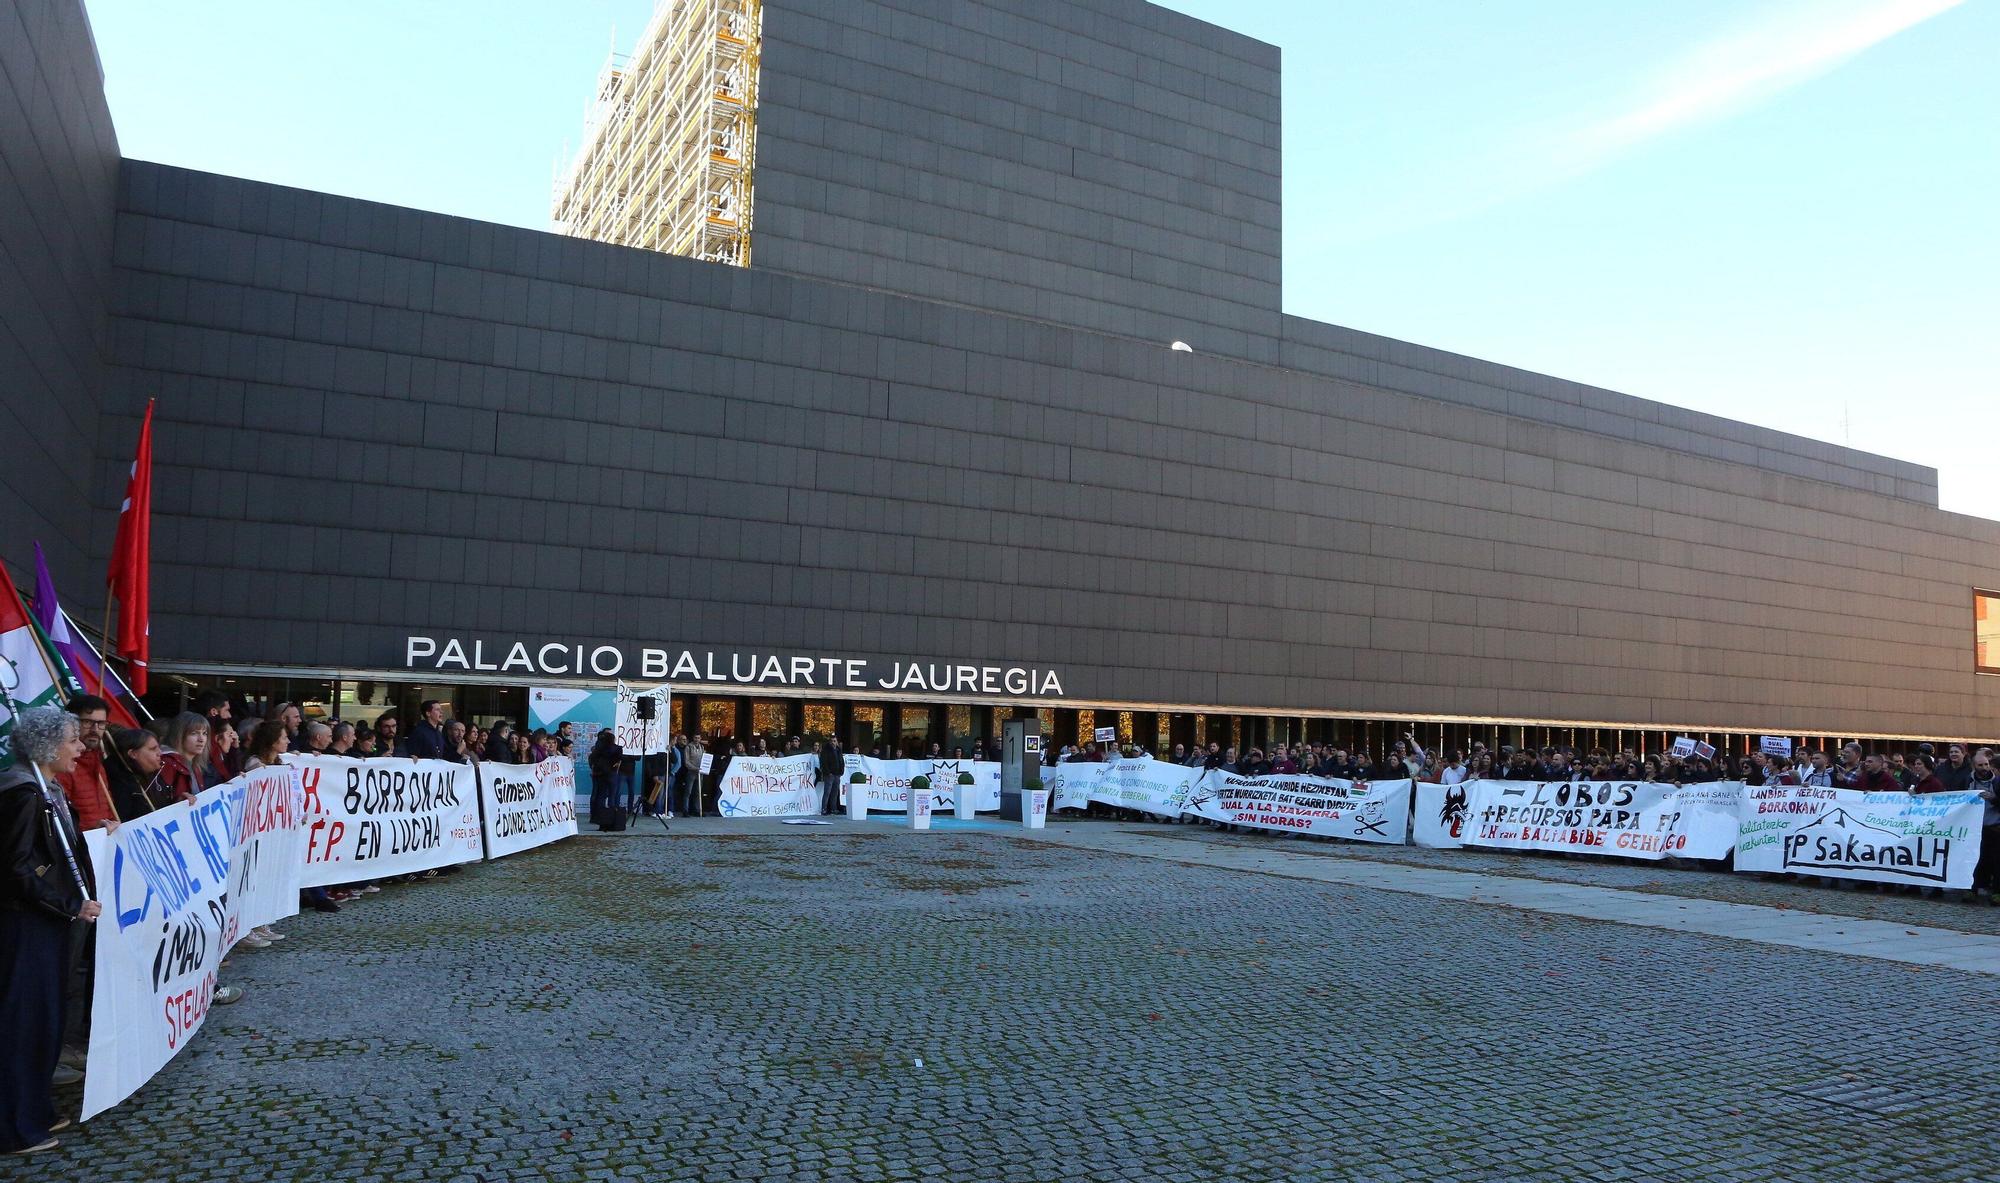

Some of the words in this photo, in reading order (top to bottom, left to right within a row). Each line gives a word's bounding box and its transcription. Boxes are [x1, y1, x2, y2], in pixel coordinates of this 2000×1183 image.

[405, 635, 623, 678] PALACIO
[640, 648, 867, 689] BALUARTE
[878, 661, 1063, 696] JAUREGIA
[344, 767, 460, 815] BORROKAN
[494, 777, 536, 804] Gimeno
[1268, 780, 1300, 793] LANBIDE
[1529, 783, 1637, 806] LOBOS
[1750, 789, 1788, 800] LANBIDE
[1795, 788, 1837, 801] HEZIKETA
[1278, 793, 1294, 804] BAT
[1220, 801, 1243, 810] DUAL
[1246, 801, 1255, 811] A
[1257, 803, 1272, 812] LA
[1276, 806, 1340, 820] NAVARRA
[1758, 802, 1827, 817] BORROKAN!
[1260, 814, 1313, 829] HORAS?
[1591, 810, 1640, 830] PARA
[1656, 812, 1681, 832] FP
[355, 820, 381, 861] EN
[391, 813, 441, 855] LUCHA
